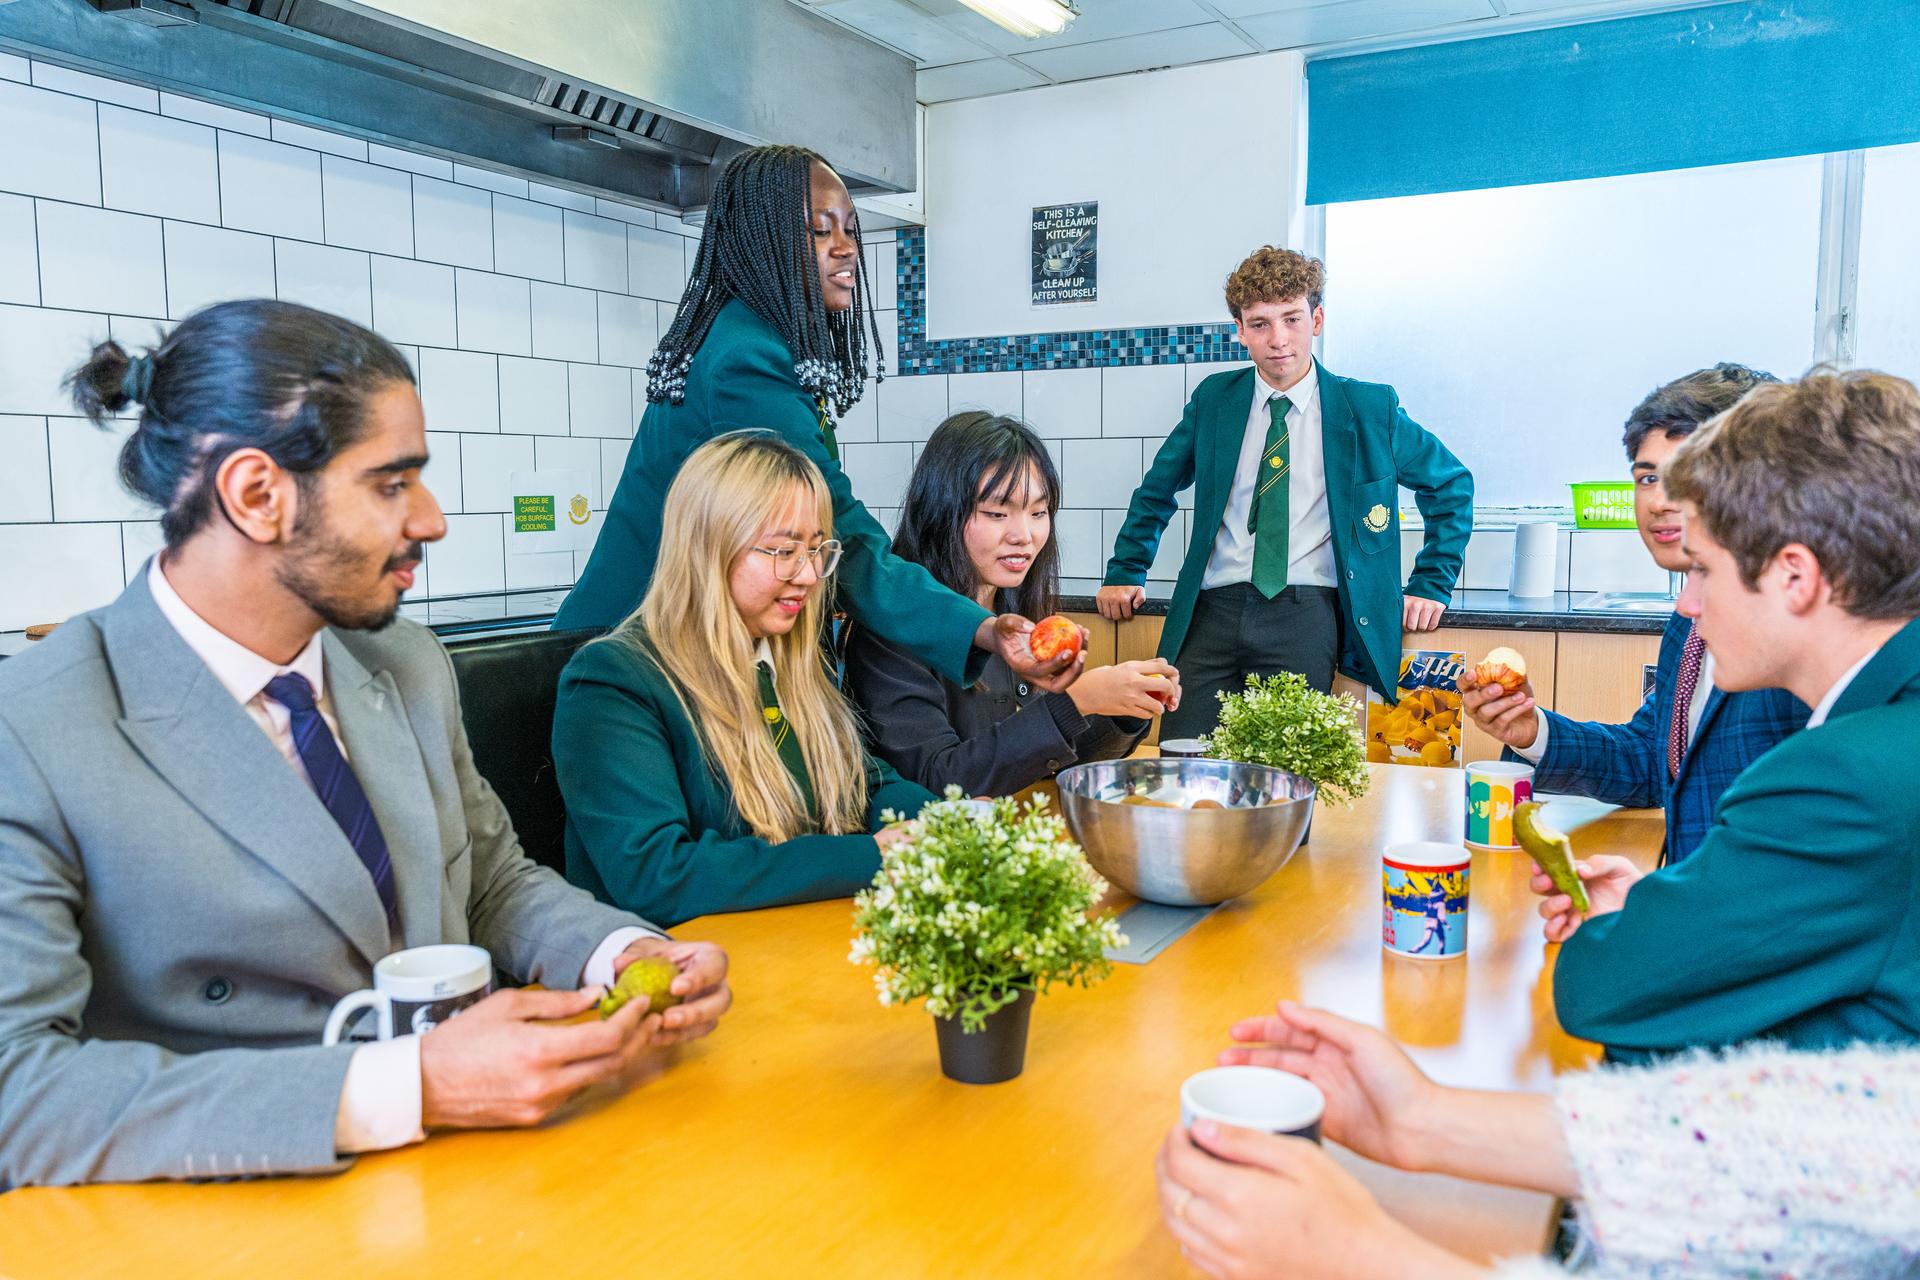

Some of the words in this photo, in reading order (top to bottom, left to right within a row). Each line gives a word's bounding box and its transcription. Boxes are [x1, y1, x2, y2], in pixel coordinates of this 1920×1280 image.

[1044, 210, 1063, 220] THIS
[1066, 207, 1075, 217] IS
[1077, 206, 1085, 217] A
[1033, 217, 1097, 231] SELF-CLEANING
[1046, 228, 1083, 240] KITCHEN
[1042, 279, 1071, 289] CLEAN
[1073, 276, 1085, 287] UP
[1032, 291, 1056, 301] AFTER
[1058, 287, 1097, 299] YOURSELF
